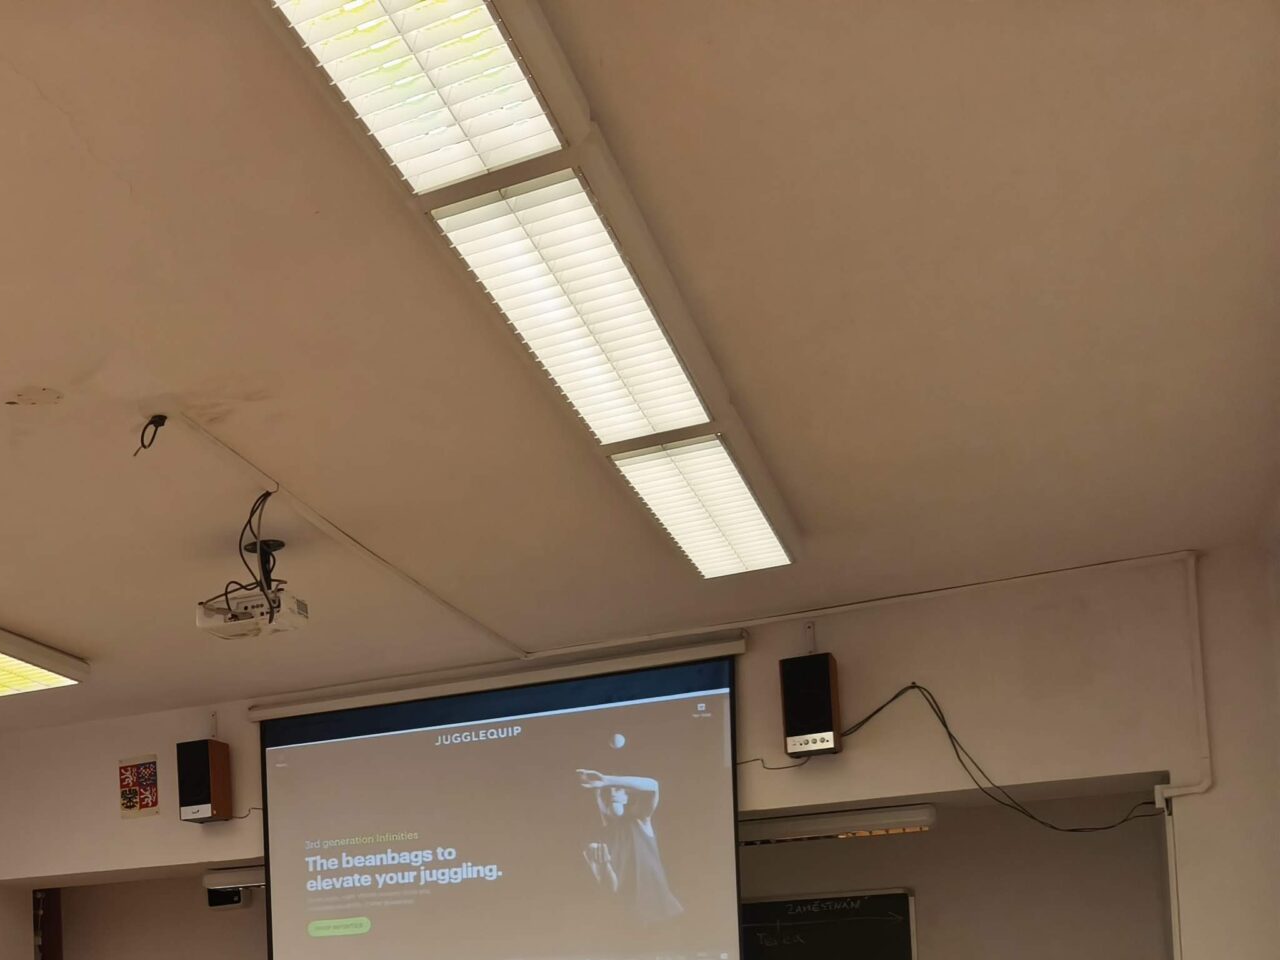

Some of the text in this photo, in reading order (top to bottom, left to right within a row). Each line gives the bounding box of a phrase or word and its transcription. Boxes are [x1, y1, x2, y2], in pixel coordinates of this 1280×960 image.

[435, 726, 522, 746] JUGGLEQUIP
[323, 834, 375, 848] generation
[376, 831, 419, 843] Infinities
[305, 847, 457, 872] The beanbags to
[306, 862, 503, 892] elevate your juggling.
